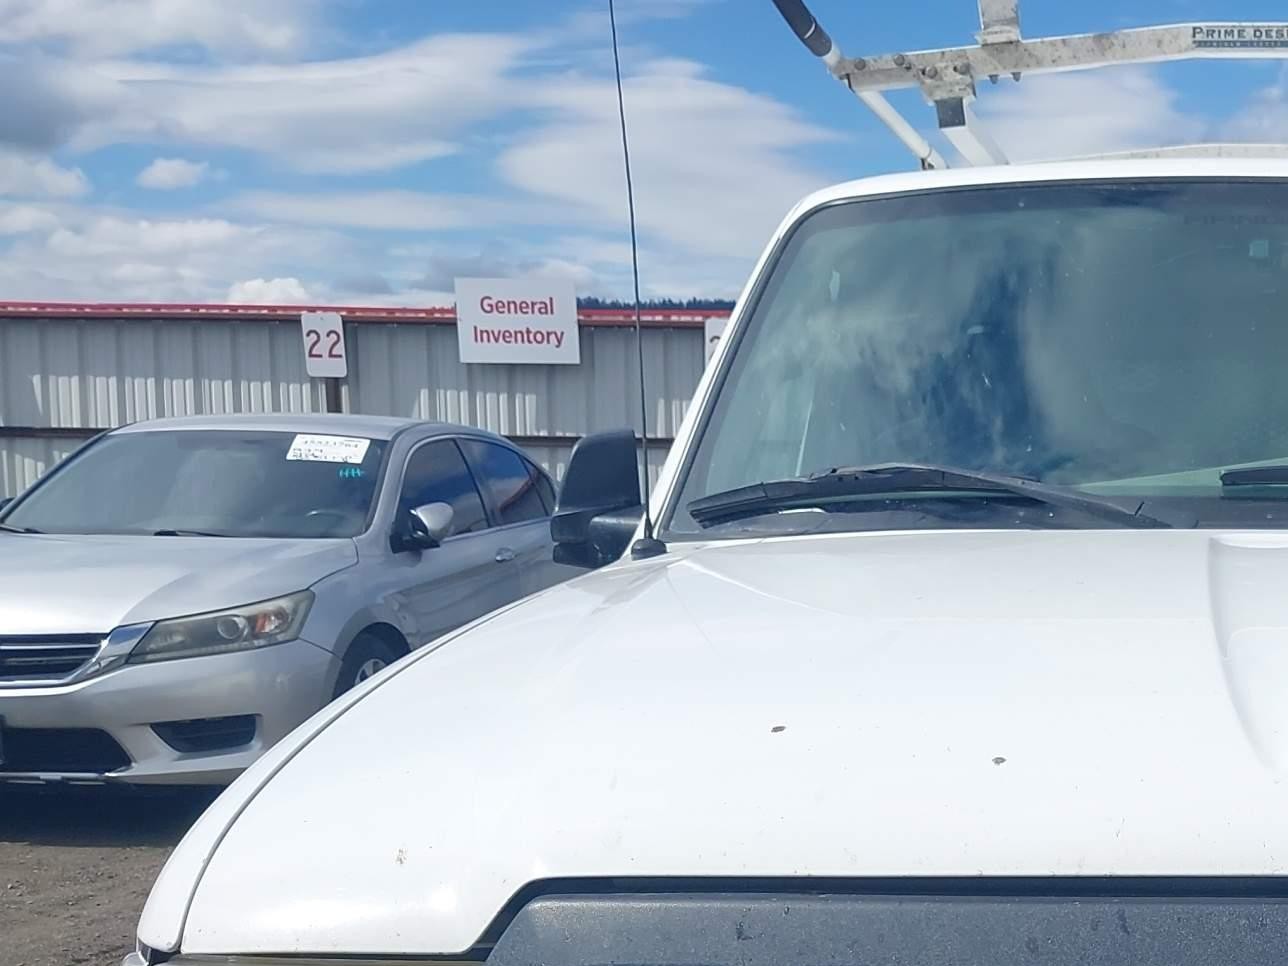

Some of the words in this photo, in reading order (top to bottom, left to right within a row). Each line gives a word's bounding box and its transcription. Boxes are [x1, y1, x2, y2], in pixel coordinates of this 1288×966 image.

[1192, 26, 1246, 39] PRIME
[479, 295, 554, 316] General
[305, 329, 343, 359] 22
[473, 325, 565, 348] Inventory
